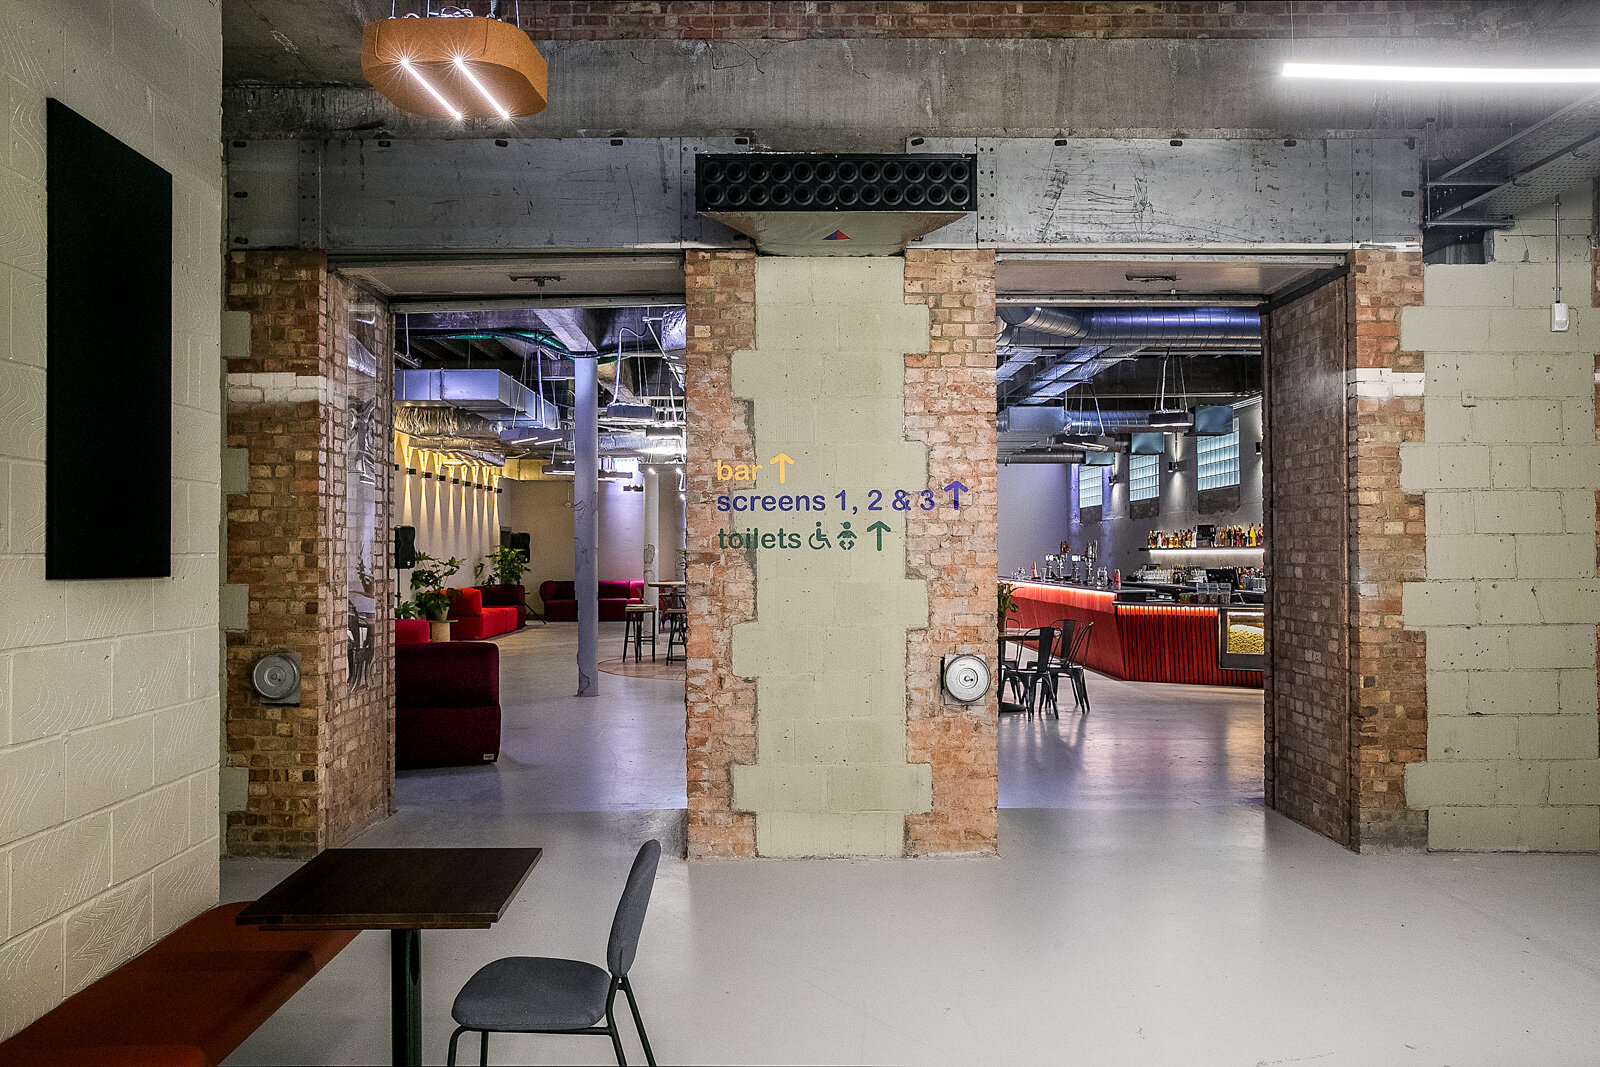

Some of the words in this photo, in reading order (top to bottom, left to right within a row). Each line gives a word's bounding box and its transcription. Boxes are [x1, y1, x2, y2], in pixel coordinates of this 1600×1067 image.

[717, 459, 763, 481] bar
[717, 495, 826, 511] screens
[835, 489, 858, 515] 1,
[867, 489, 883, 511] 2
[891, 489, 912, 511] &
[920, 489, 935, 511] 3
[717, 527, 802, 549] toilets
